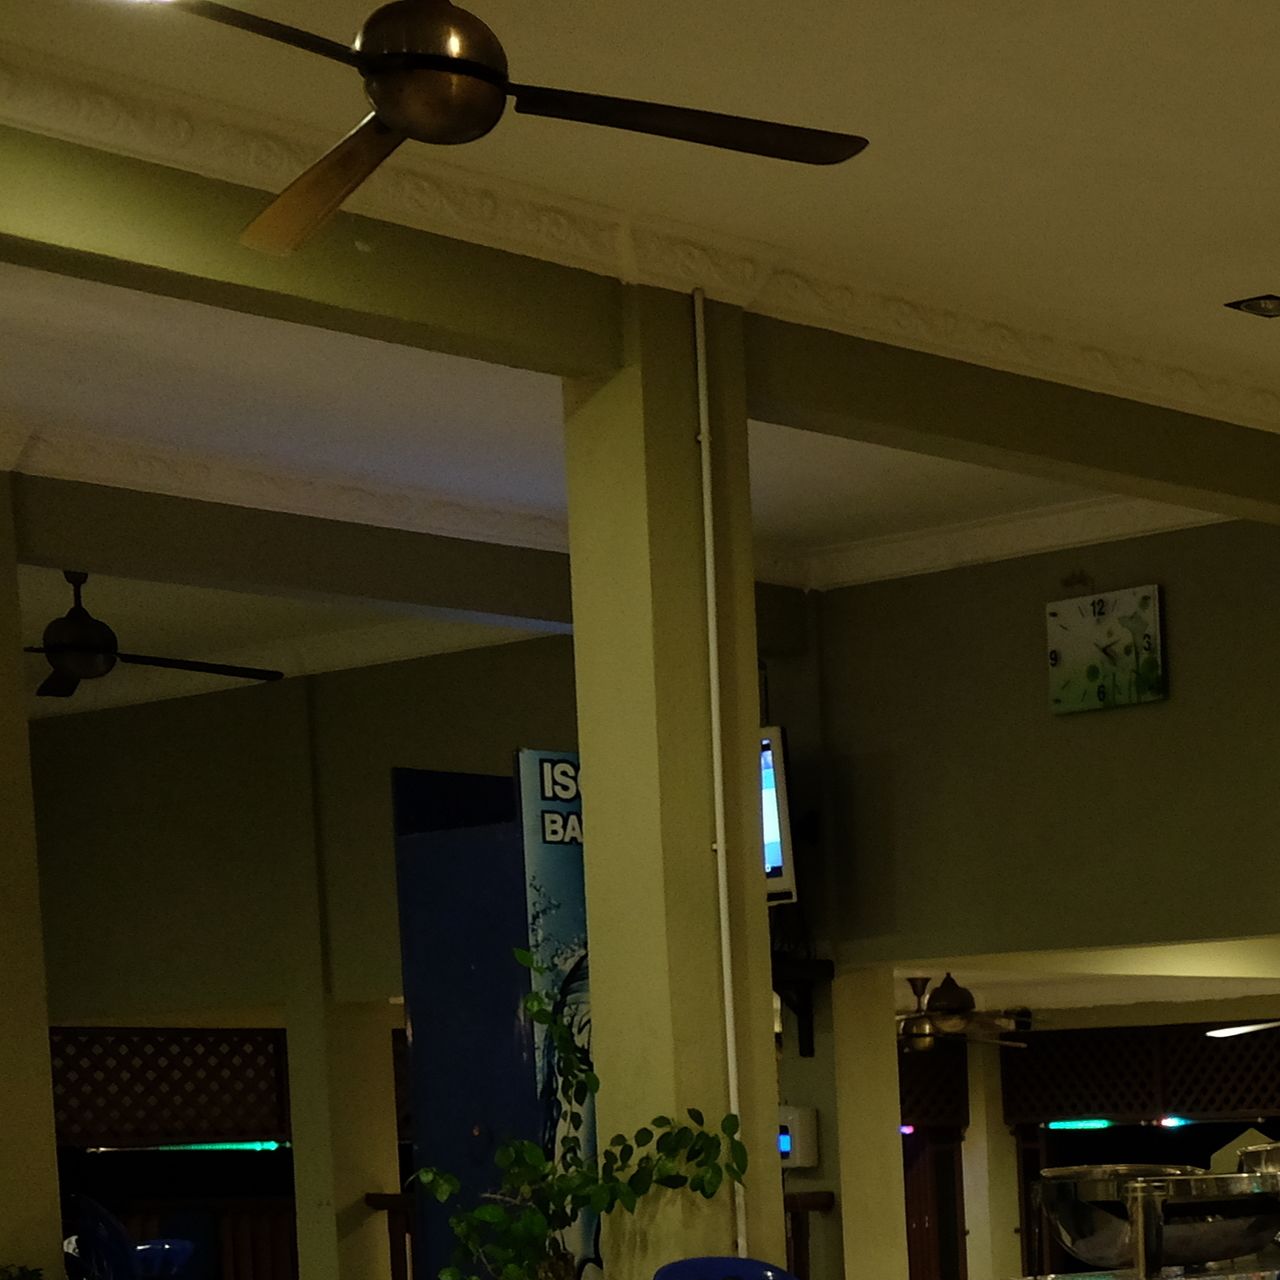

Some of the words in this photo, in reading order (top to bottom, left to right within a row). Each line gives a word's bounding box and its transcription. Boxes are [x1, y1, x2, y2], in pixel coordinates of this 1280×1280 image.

[1091, 599, 1105, 616] 12
[1143, 634, 1152, 651] 3
[1049, 650, 1058, 667] 9
[1097, 684, 1106, 702] 6
[541, 760, 580, 801] IS
